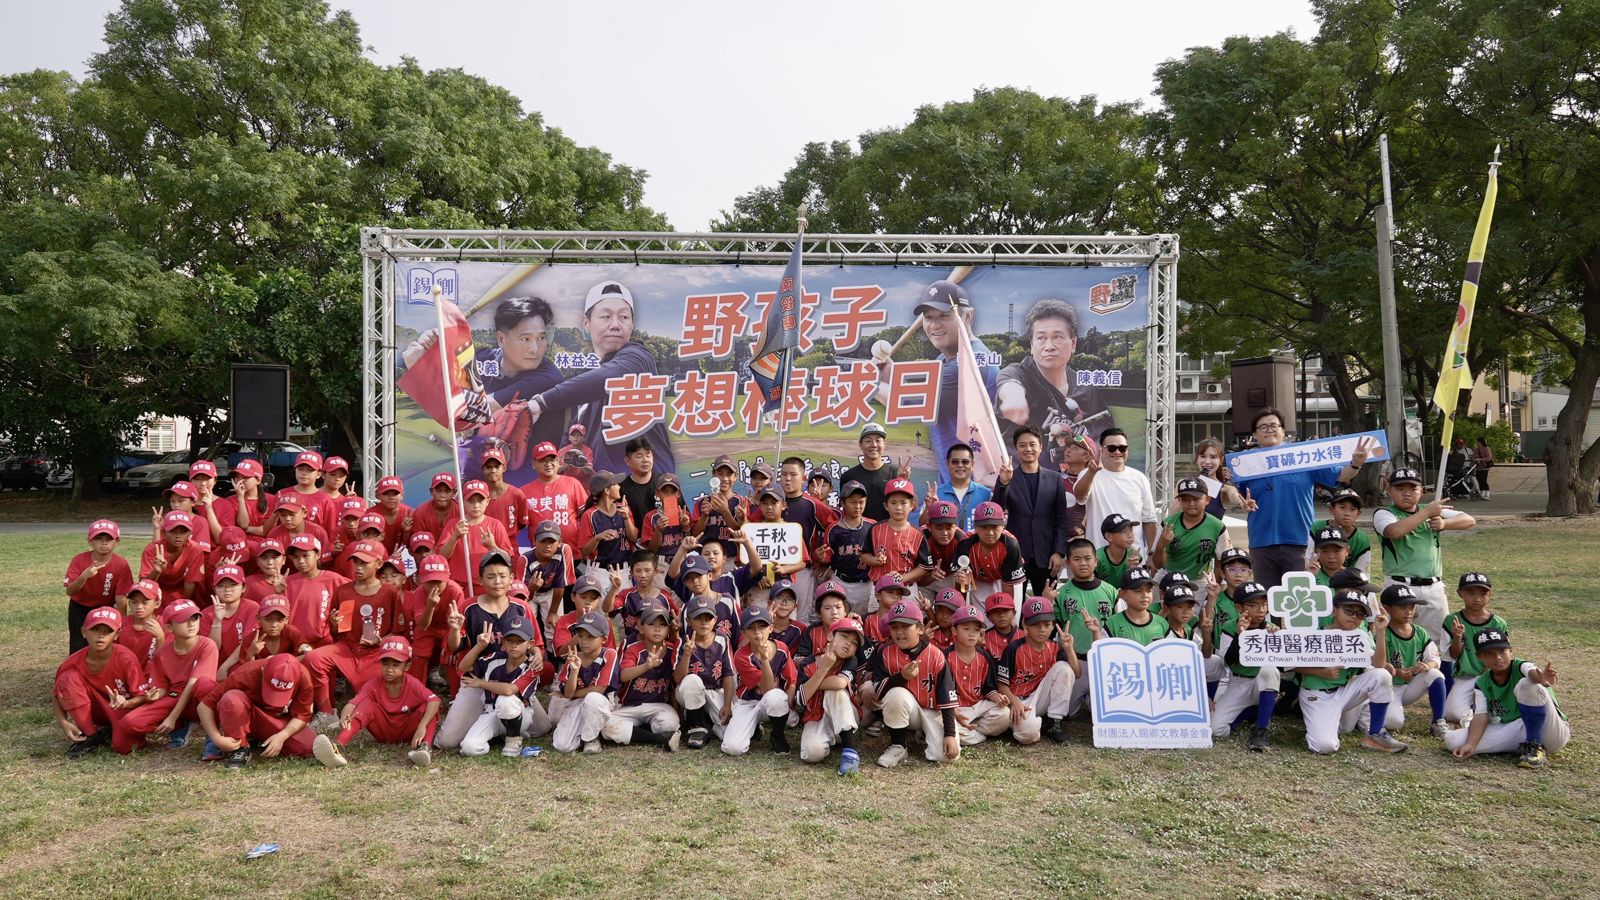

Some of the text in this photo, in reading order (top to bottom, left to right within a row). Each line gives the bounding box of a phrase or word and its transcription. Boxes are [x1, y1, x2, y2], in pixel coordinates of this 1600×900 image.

[555, 352, 600, 368] 林益全
[1077, 370, 1122, 386] 陳義信
[602, 358, 943, 445] 夢想棒球日
[1265, 445, 1343, 470] 寶礦力水得
[553, 511, 569, 525] 88
[755, 527, 787, 543] 千秋
[755, 544, 787, 560] 國小
[1244, 634, 1365, 654] 秀傳醫療體系
[1297, 655, 1336, 663] Healthcare
[1106, 661, 1193, 701] 錫卿
[1097, 727, 1209, 739] 財團法人錫卿文教基金會
